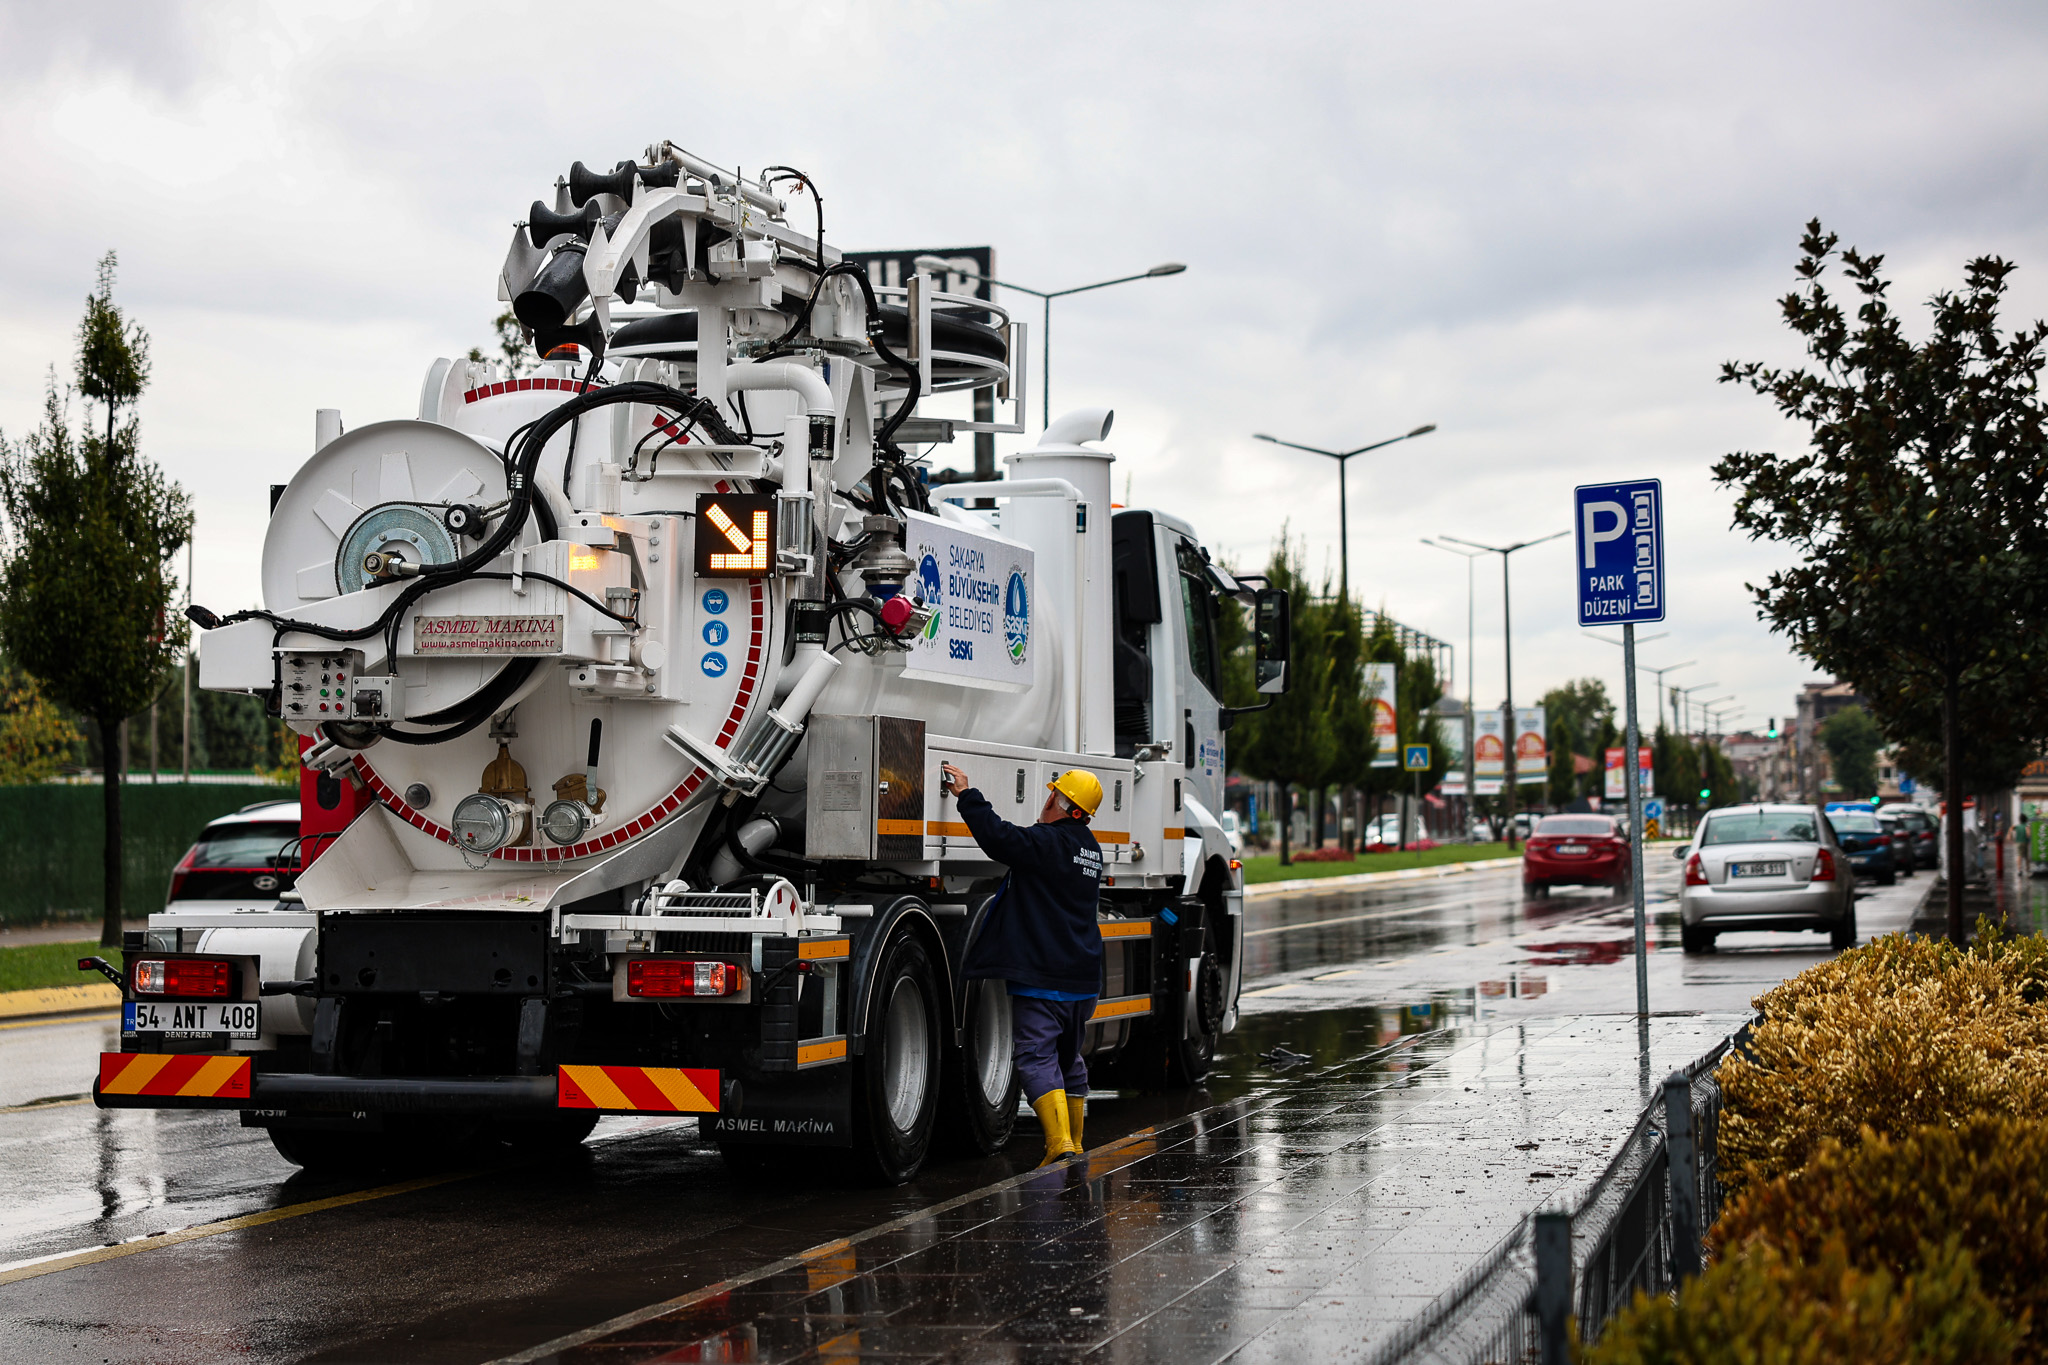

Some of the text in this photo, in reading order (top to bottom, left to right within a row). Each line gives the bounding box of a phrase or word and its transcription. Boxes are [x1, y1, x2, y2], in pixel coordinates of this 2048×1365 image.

[1583, 501, 1628, 569] P
[949, 544, 985, 573] SAKARYA
[949, 570, 999, 606] BÜYÜKŞEHİR
[1590, 575, 1624, 592] PARK
[1584, 594, 1631, 617] DÜZENİ
[421, 616, 556, 634] ASMEL MAKİNA
[949, 606, 994, 634] BELEDİYESİ
[421, 638, 555, 648] www.asmelmakina.com.tr
[126, 1005, 255, 1029] TR 54 ANT 408
[715, 1118, 834, 1133] ASMEL MAKİNA
